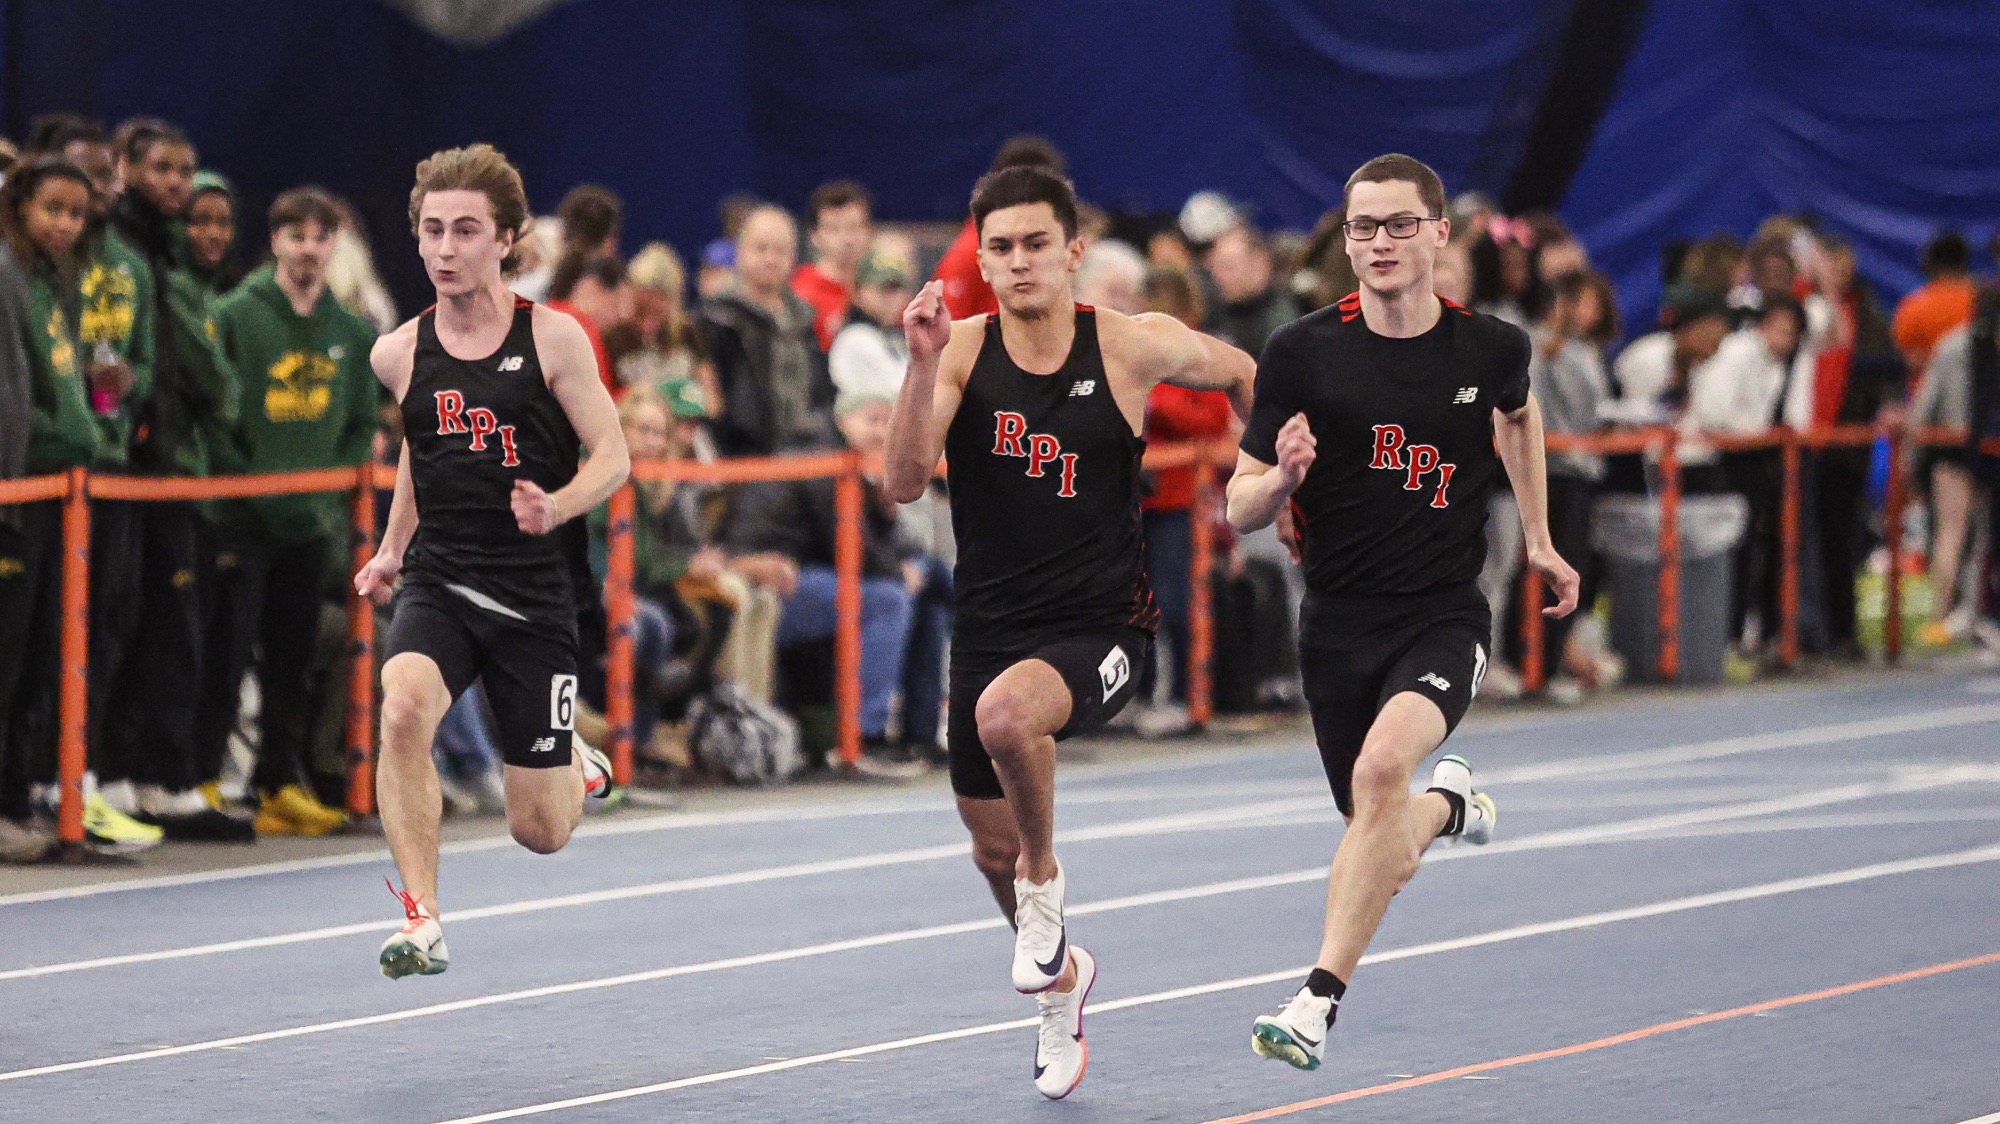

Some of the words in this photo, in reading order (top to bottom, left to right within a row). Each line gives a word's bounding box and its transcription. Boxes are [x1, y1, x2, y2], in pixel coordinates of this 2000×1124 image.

[497, 356, 524, 372] NB
[1068, 380, 1096, 397] NB
[1452, 387, 1478, 404] NB
[434, 390, 520, 467] RPI
[991, 411, 1079, 497] RPI
[1368, 424, 1456, 508] RPI
[1103, 655, 1127, 691] 5
[557, 679, 572, 727] 6
